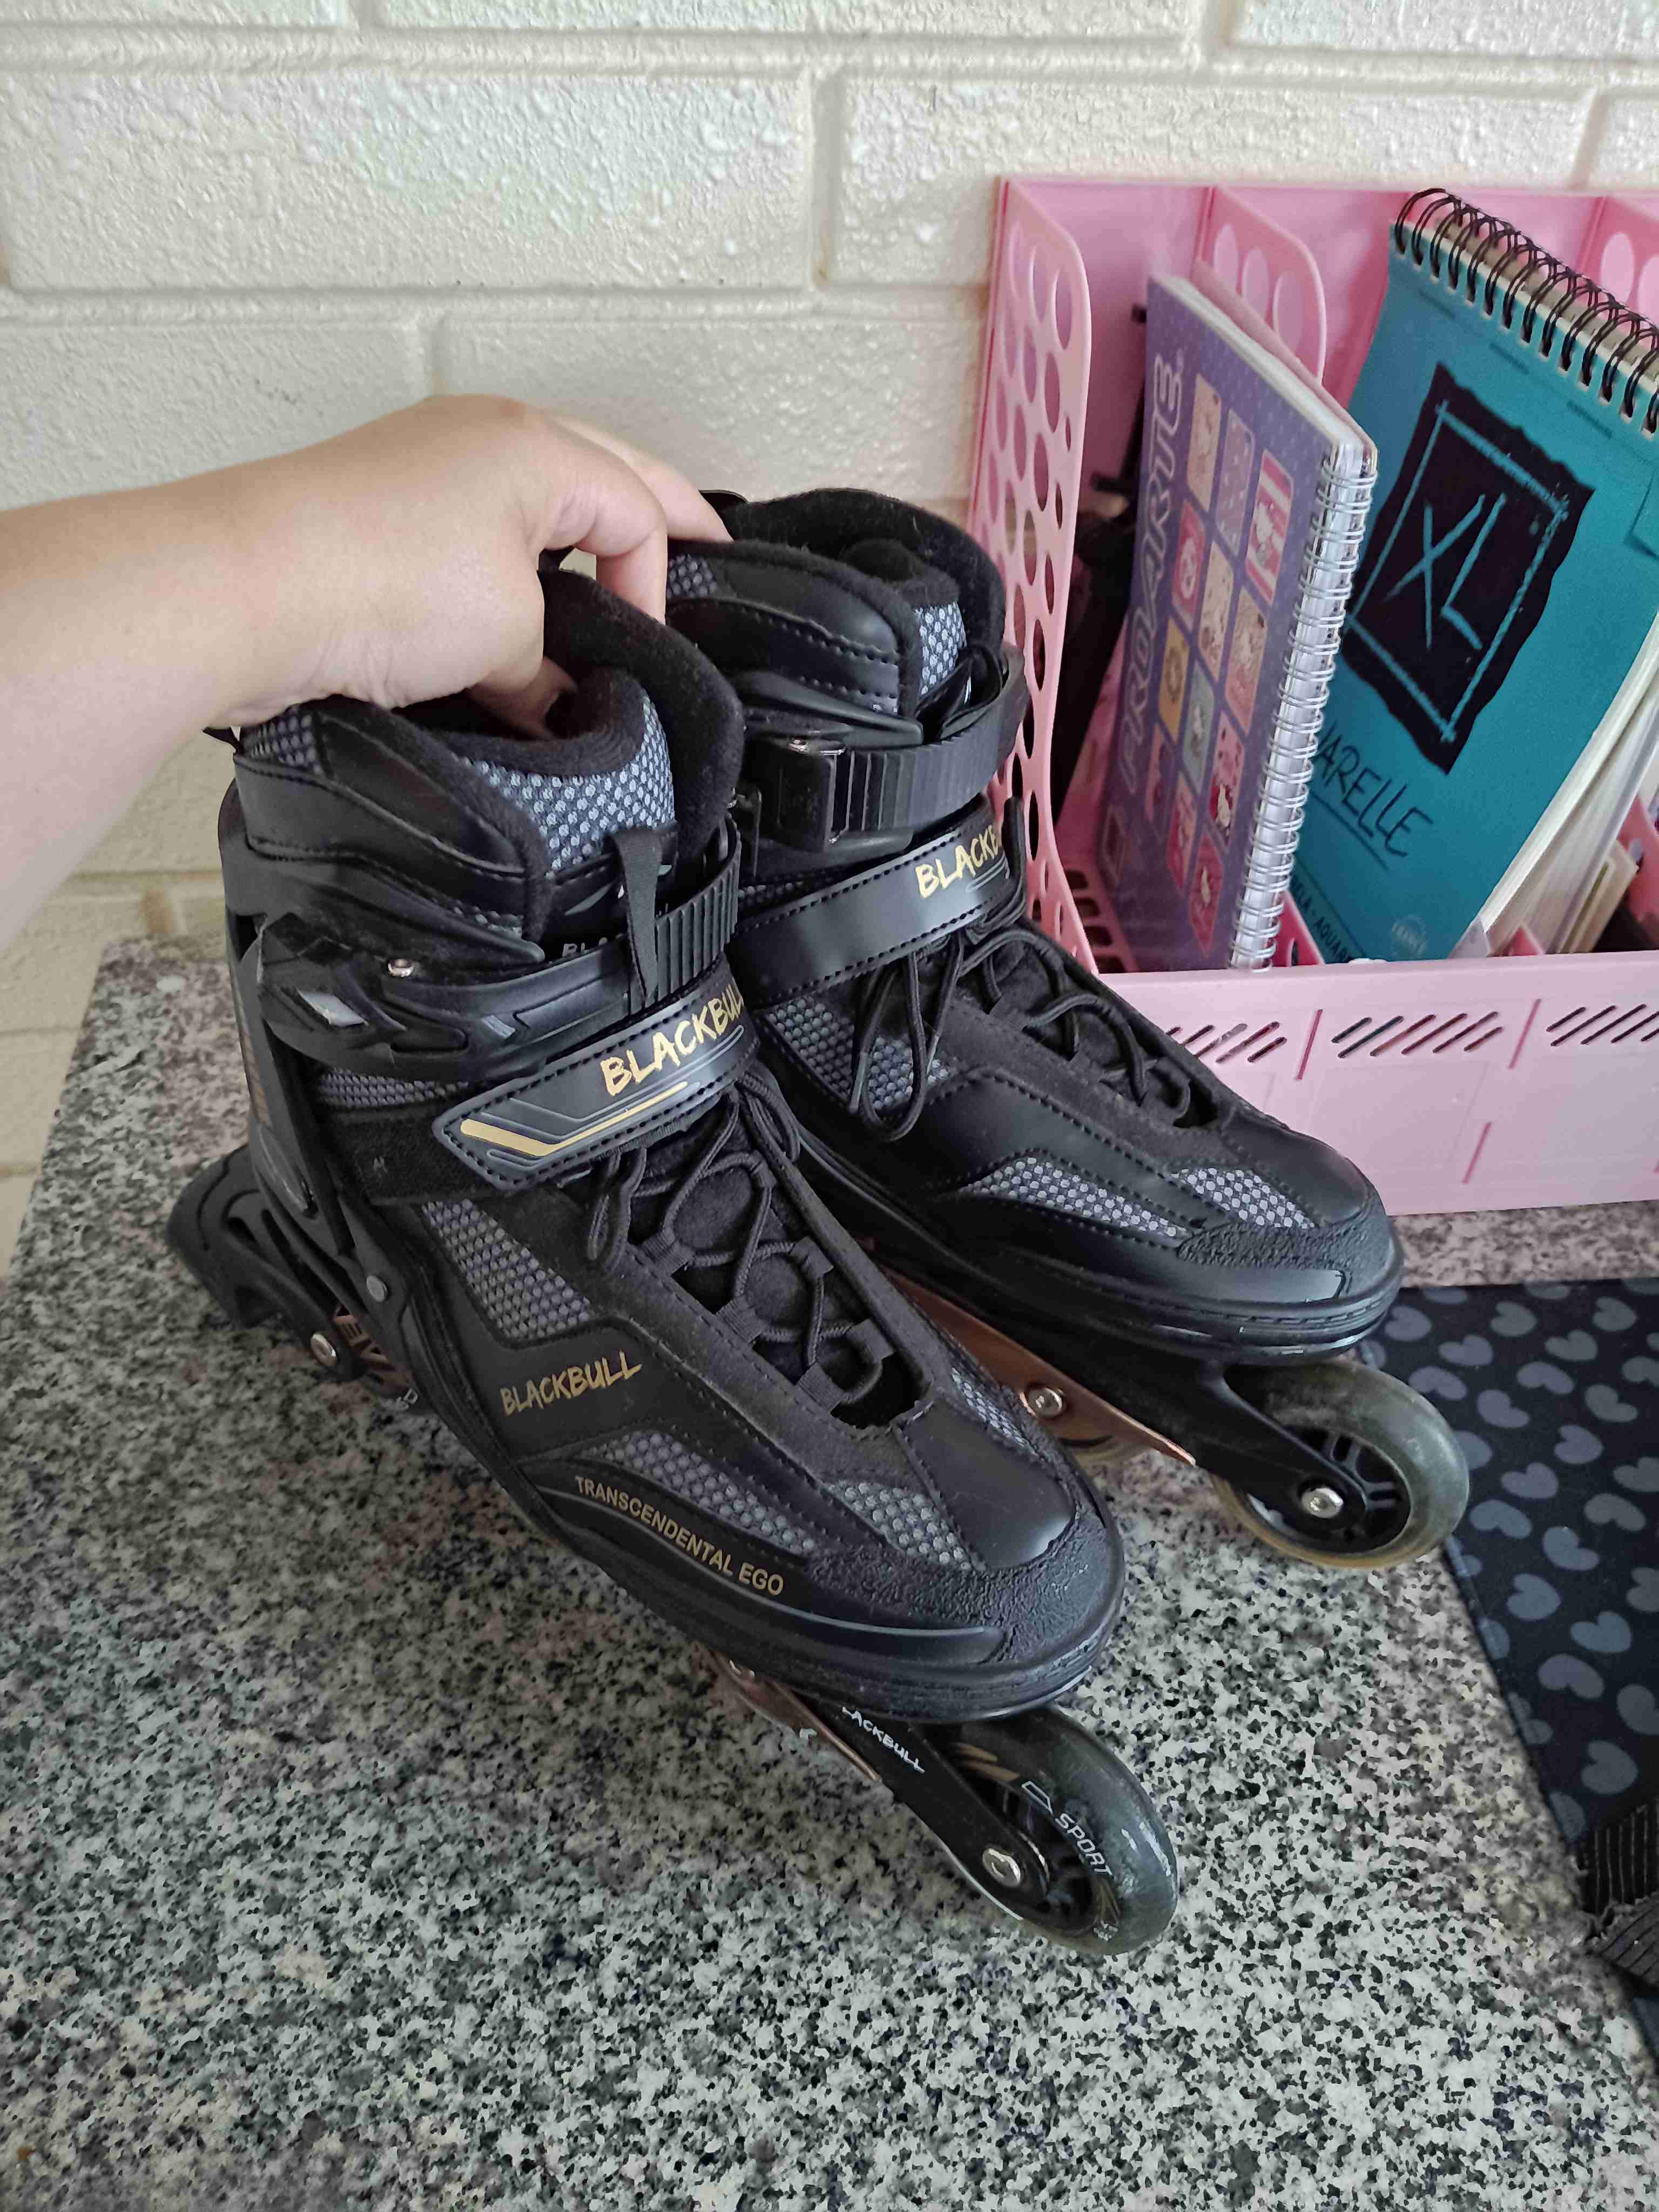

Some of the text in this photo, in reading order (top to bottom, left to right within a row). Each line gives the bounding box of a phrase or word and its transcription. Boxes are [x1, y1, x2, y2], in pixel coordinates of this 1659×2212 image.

[1382, 493, 1507, 651] XL
[500, 1350, 643, 1416] BLACKBULL
[575, 1475, 784, 1596] TRANSCENDENTAL EGO
[1054, 1812, 1112, 1876] SPORT
